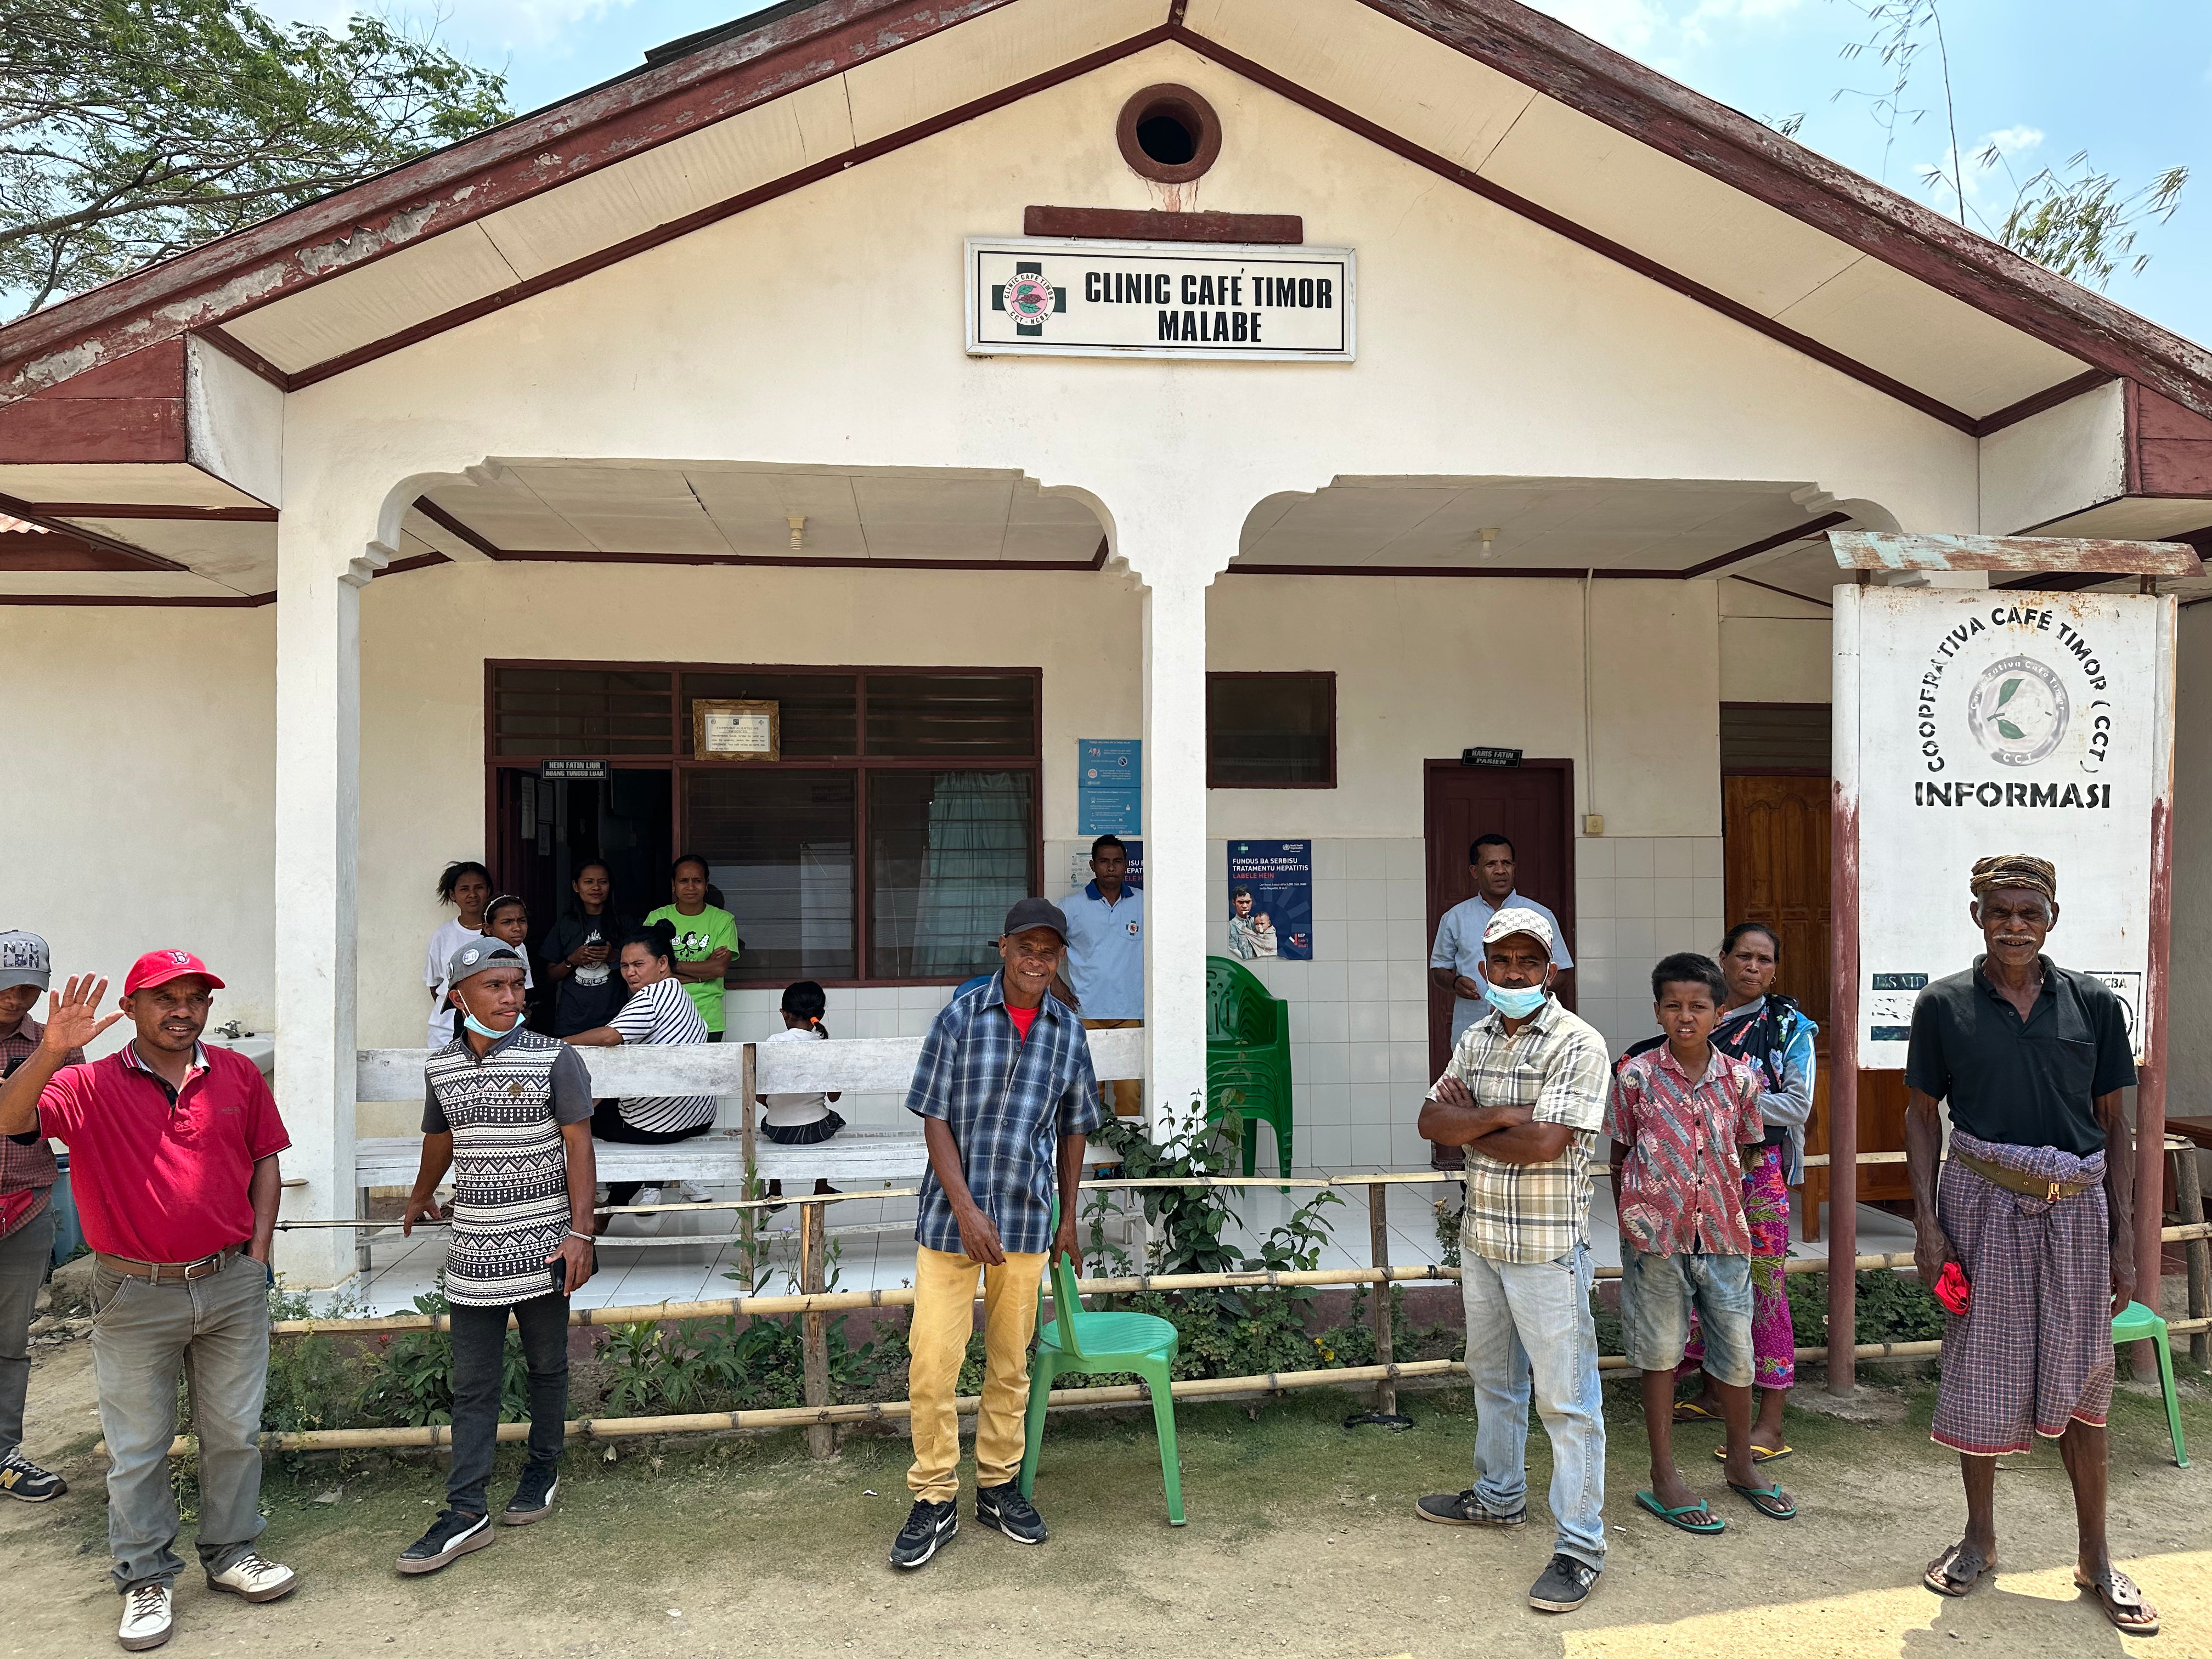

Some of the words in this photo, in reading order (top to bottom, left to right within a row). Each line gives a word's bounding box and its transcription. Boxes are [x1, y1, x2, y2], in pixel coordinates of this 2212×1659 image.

[1005, 277, 1019, 299] CLINIC
[1040, 279, 1054, 300] TIMOR
[1085, 272, 1170, 305] CLINIC
[1181, 268, 1244, 307] CAFÉ
[1252, 276, 1333, 309] TIMOR
[1010, 311, 1023, 323] CCT
[1031, 312, 1048, 324] NCBA
[1159, 311, 1261, 342] MALABE
[1919, 617, 1986, 772] COOPERATIVA
[1991, 607, 2053, 631] CAFÉ
[2056, 622, 2107, 691] TIMOR
[2002, 753, 2032, 764] CCT
[1915, 781, 2111, 808] INFORMASI
[4, 940, 39, 954] NYC
[167, 951, 190, 964] B
